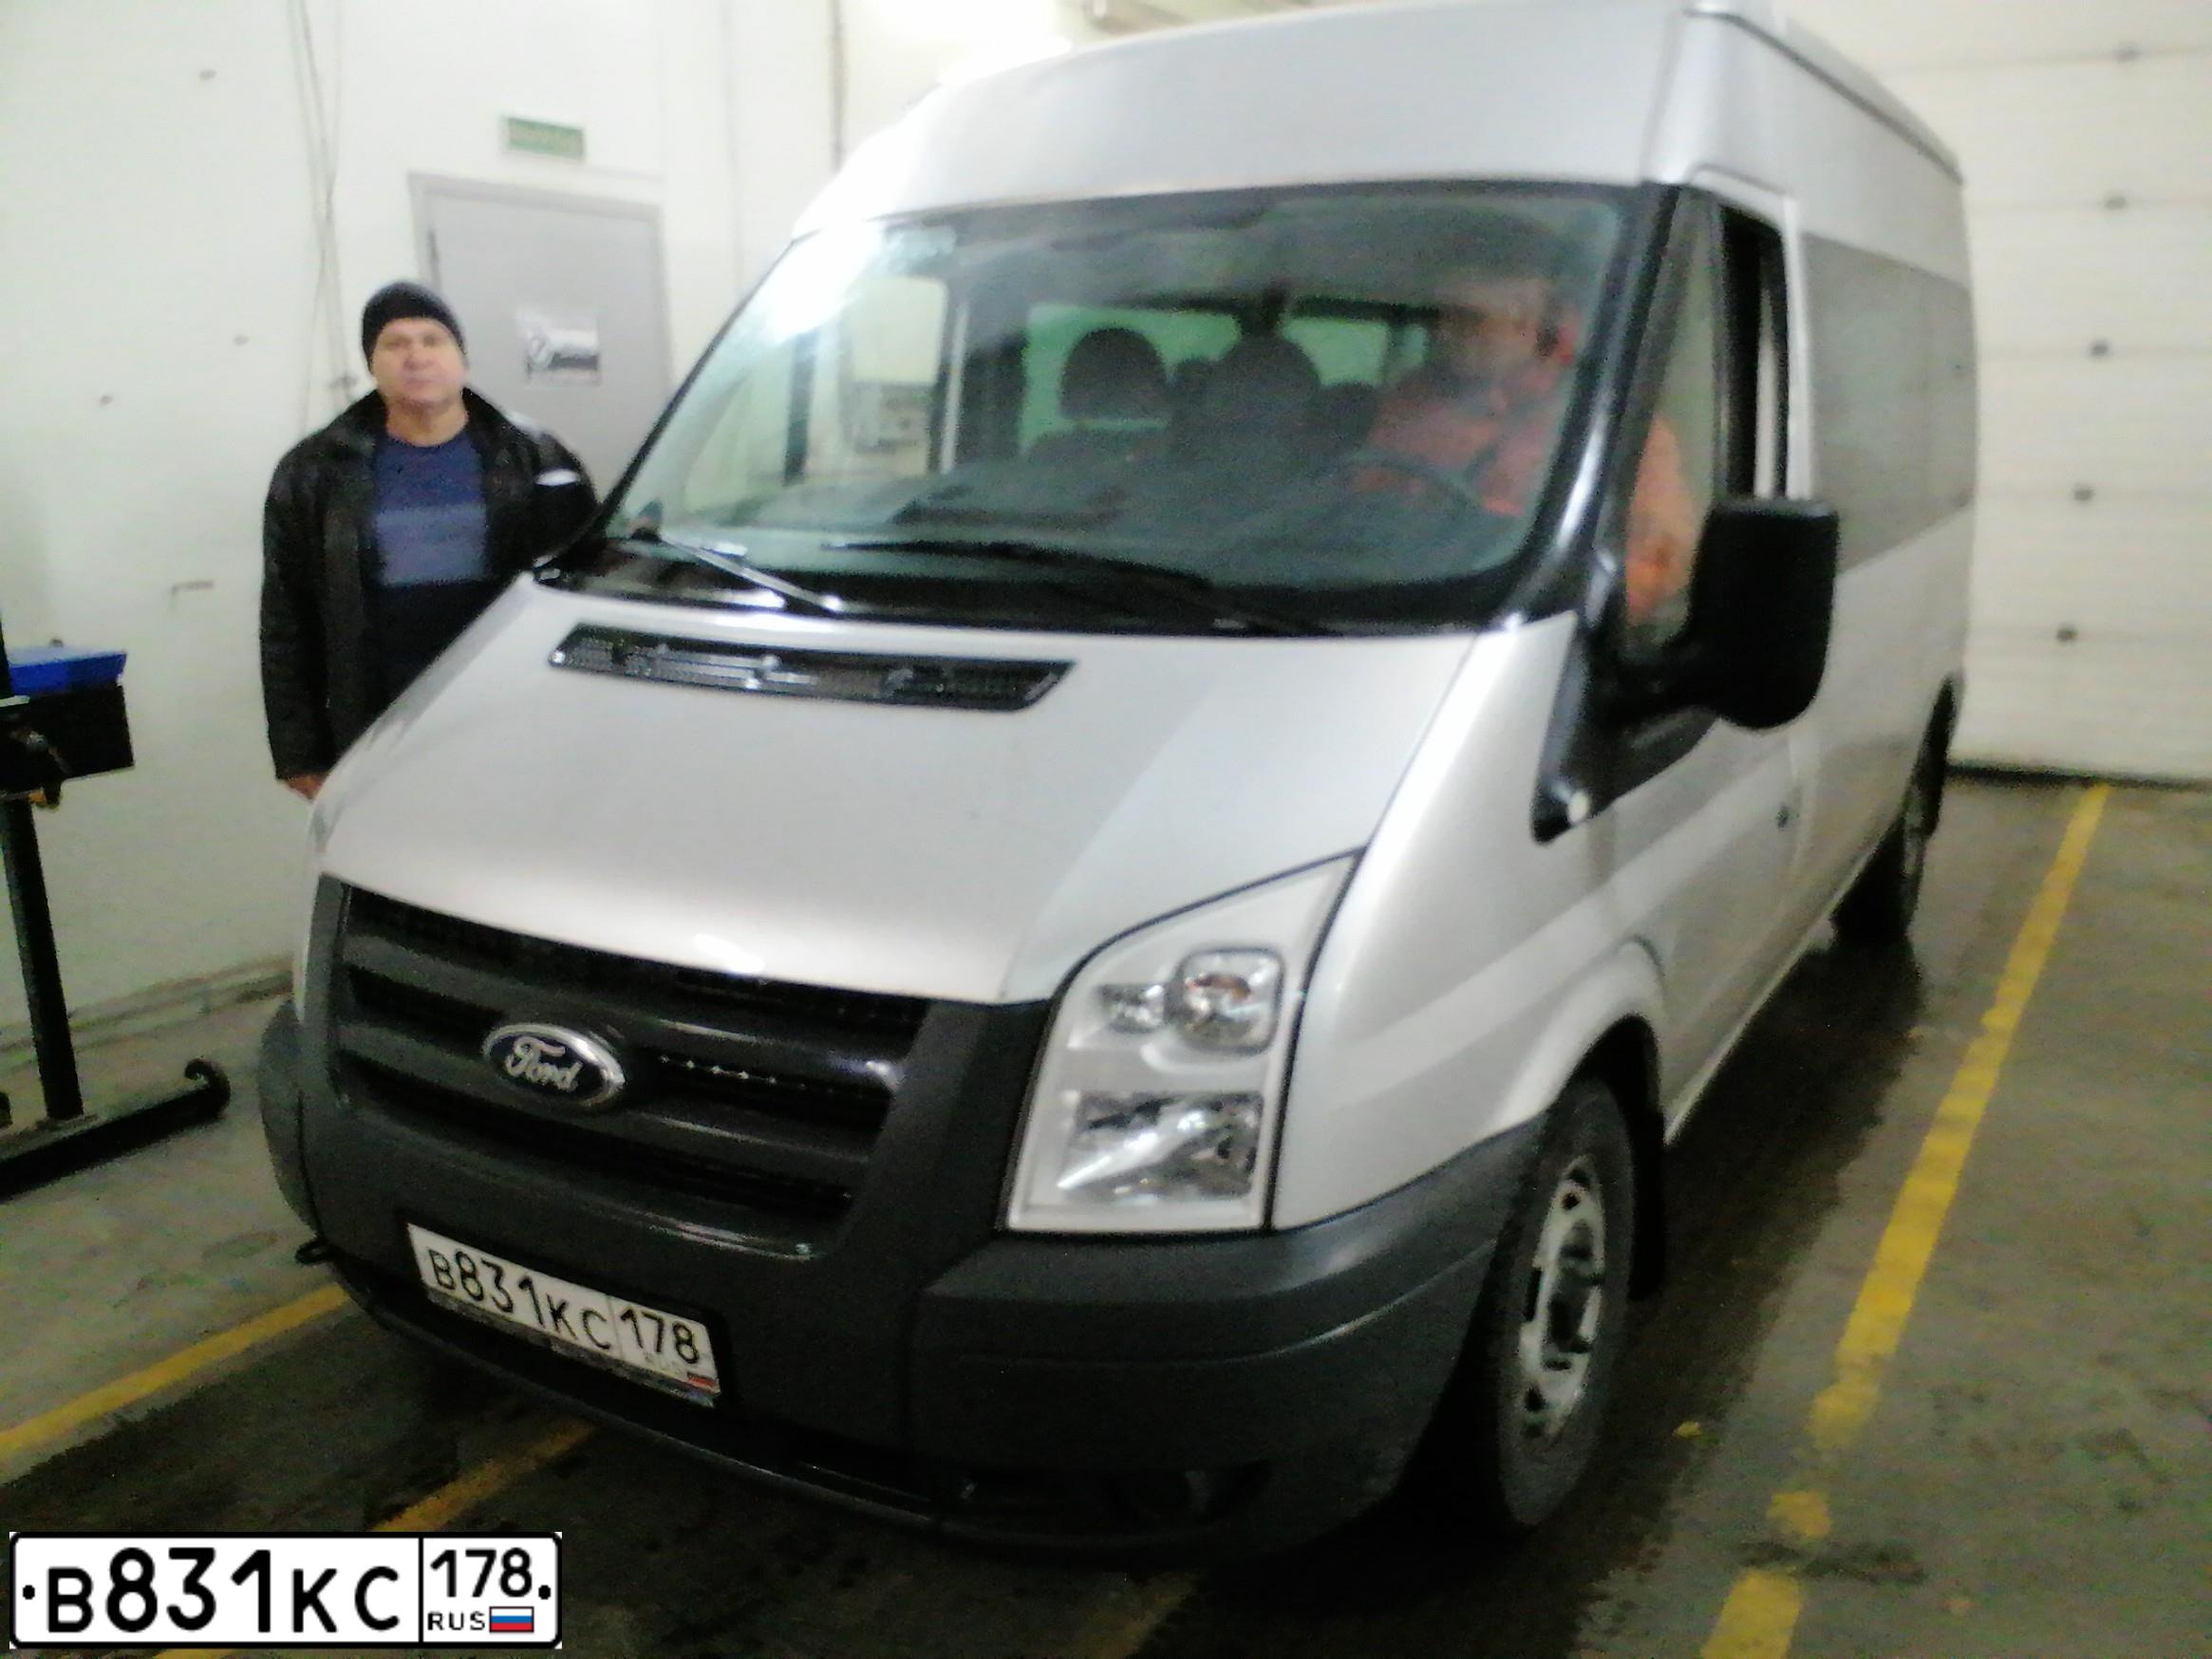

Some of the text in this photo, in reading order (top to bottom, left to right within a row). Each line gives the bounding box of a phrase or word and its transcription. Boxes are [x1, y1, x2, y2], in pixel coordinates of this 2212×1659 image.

[505, 1036, 583, 1091] Ford
[428, 1248, 699, 1365] B831KC 178
